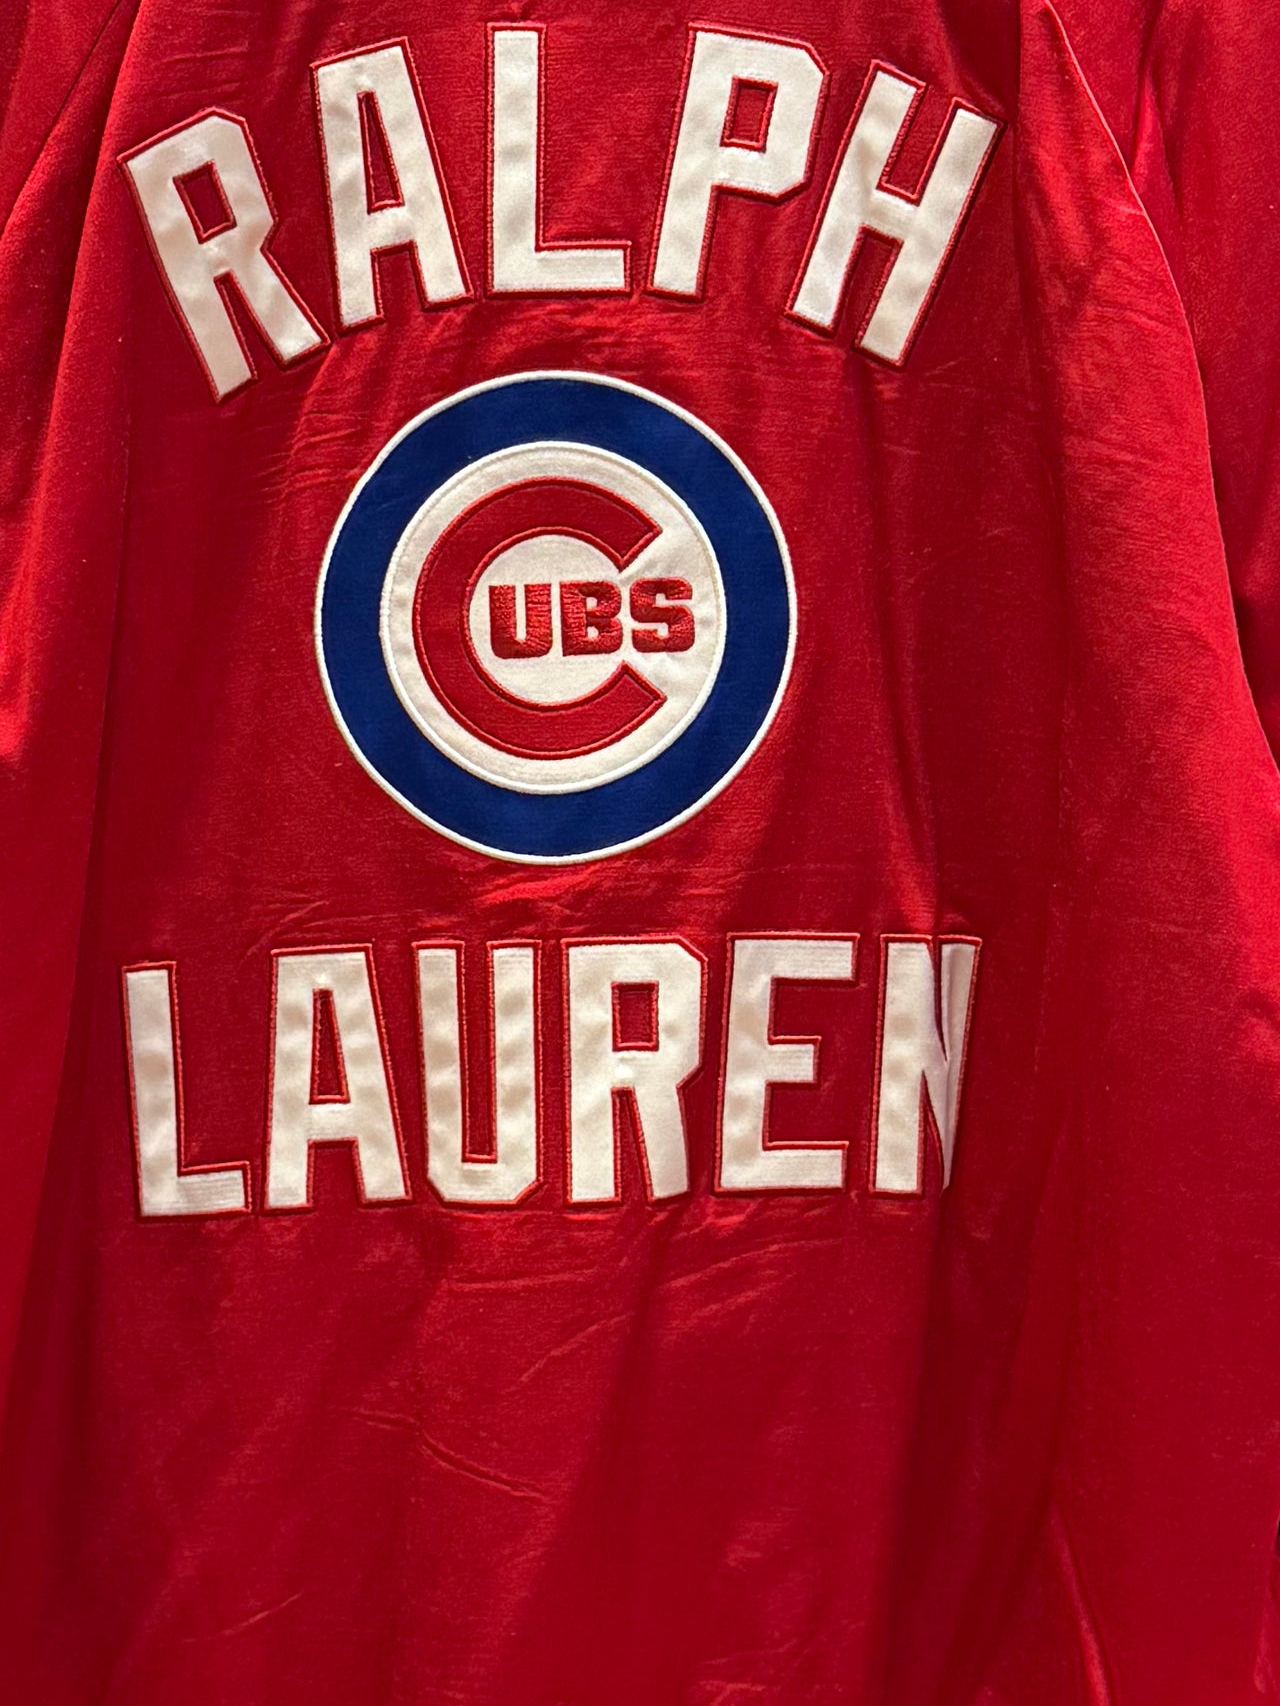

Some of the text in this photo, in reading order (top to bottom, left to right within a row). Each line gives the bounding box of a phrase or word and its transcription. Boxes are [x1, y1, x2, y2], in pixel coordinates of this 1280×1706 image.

[117, 20, 1008, 404] RALPH
[412, 476, 696, 761] CUBS
[122, 933, 982, 1219] LAUREN
